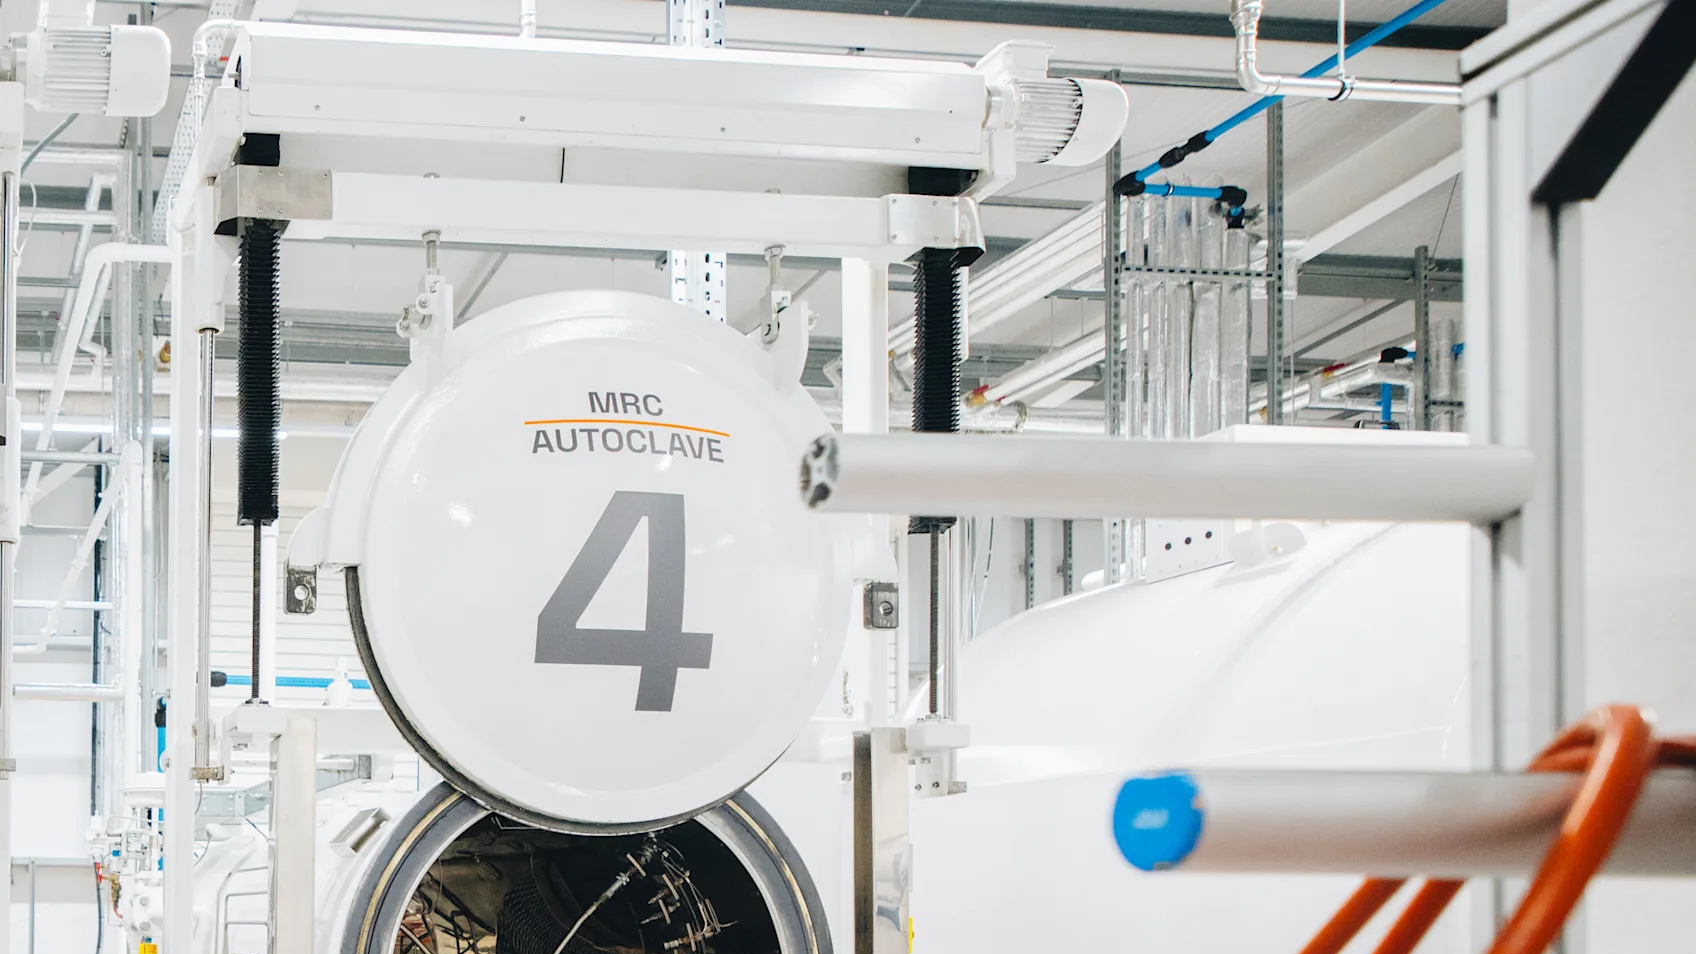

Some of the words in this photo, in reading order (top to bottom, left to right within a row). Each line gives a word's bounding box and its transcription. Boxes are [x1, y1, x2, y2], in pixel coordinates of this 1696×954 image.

[588, 391, 664, 417] MRC
[532, 428, 724, 463] AUTOCLAVE
[534, 490, 714, 712] 4
